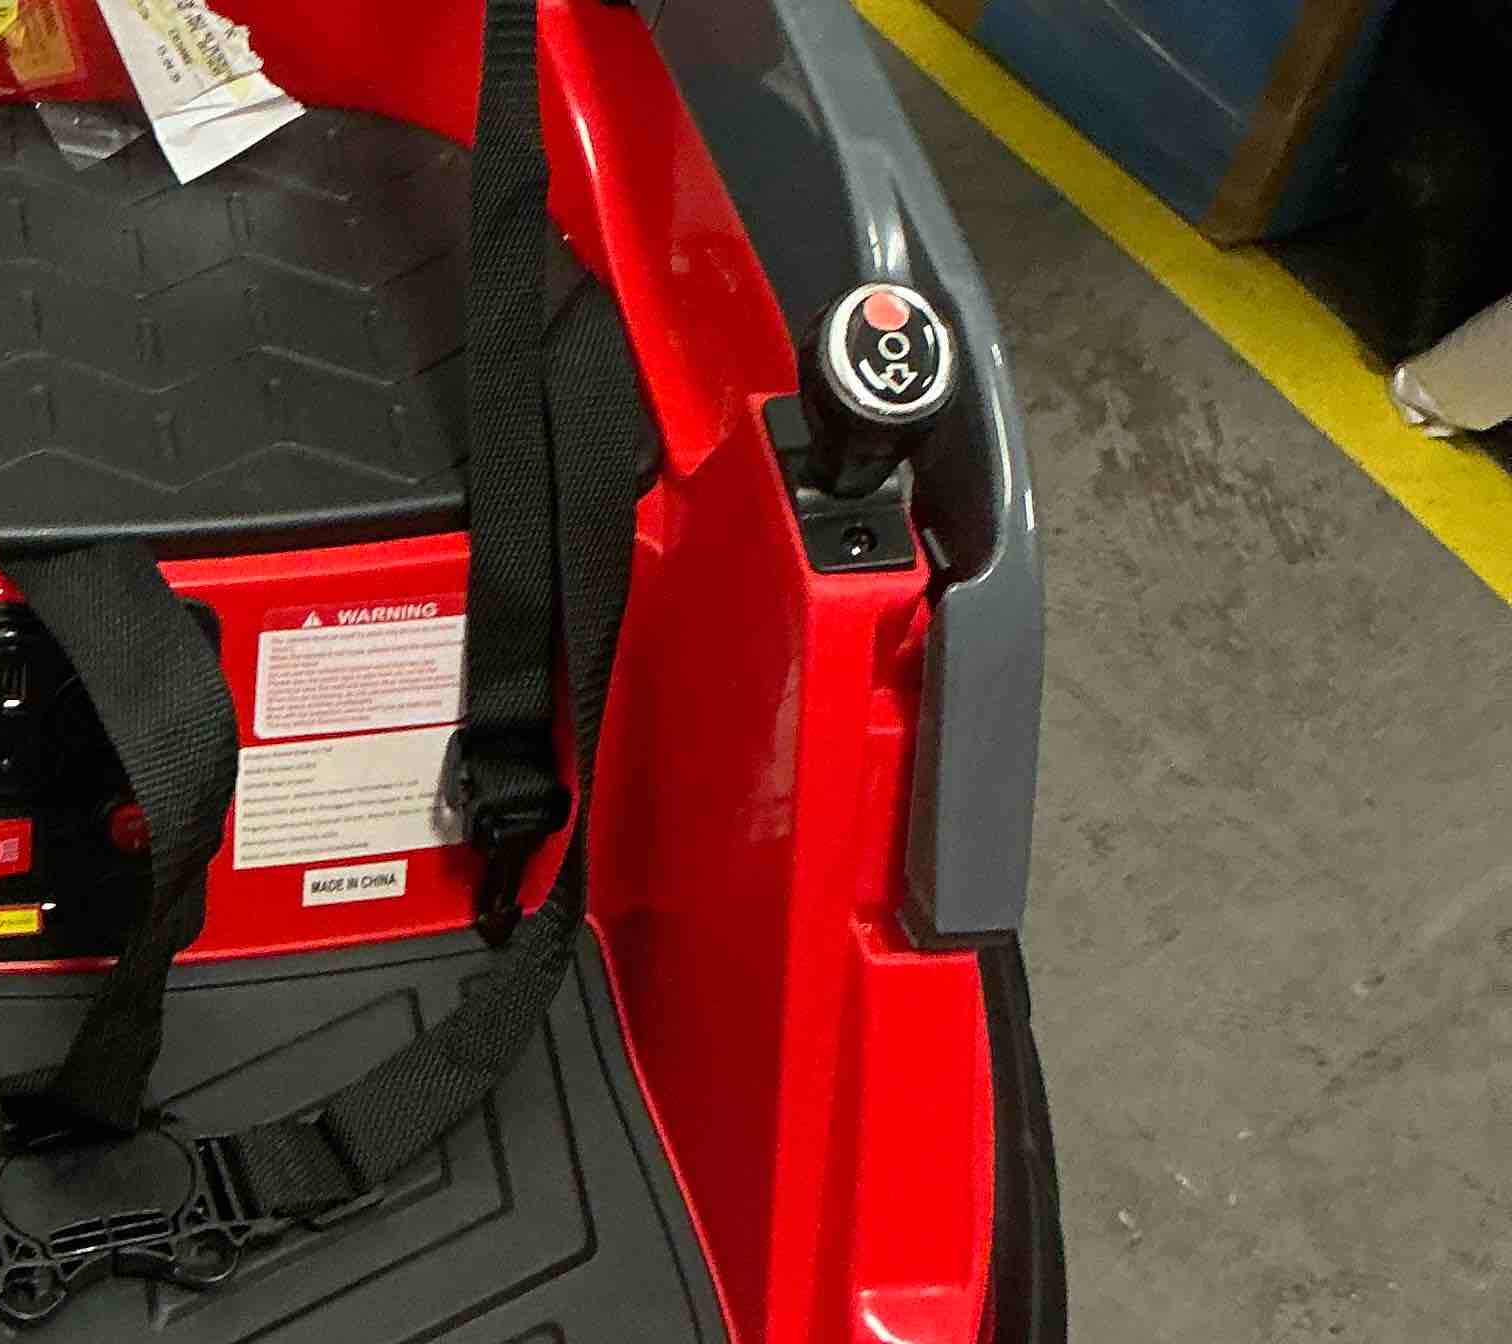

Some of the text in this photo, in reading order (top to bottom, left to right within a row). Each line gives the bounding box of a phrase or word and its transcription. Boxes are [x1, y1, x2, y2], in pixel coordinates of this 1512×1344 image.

[336, 601, 439, 626] WARNING
[311, 873, 396, 893] MADE IN CHINA
